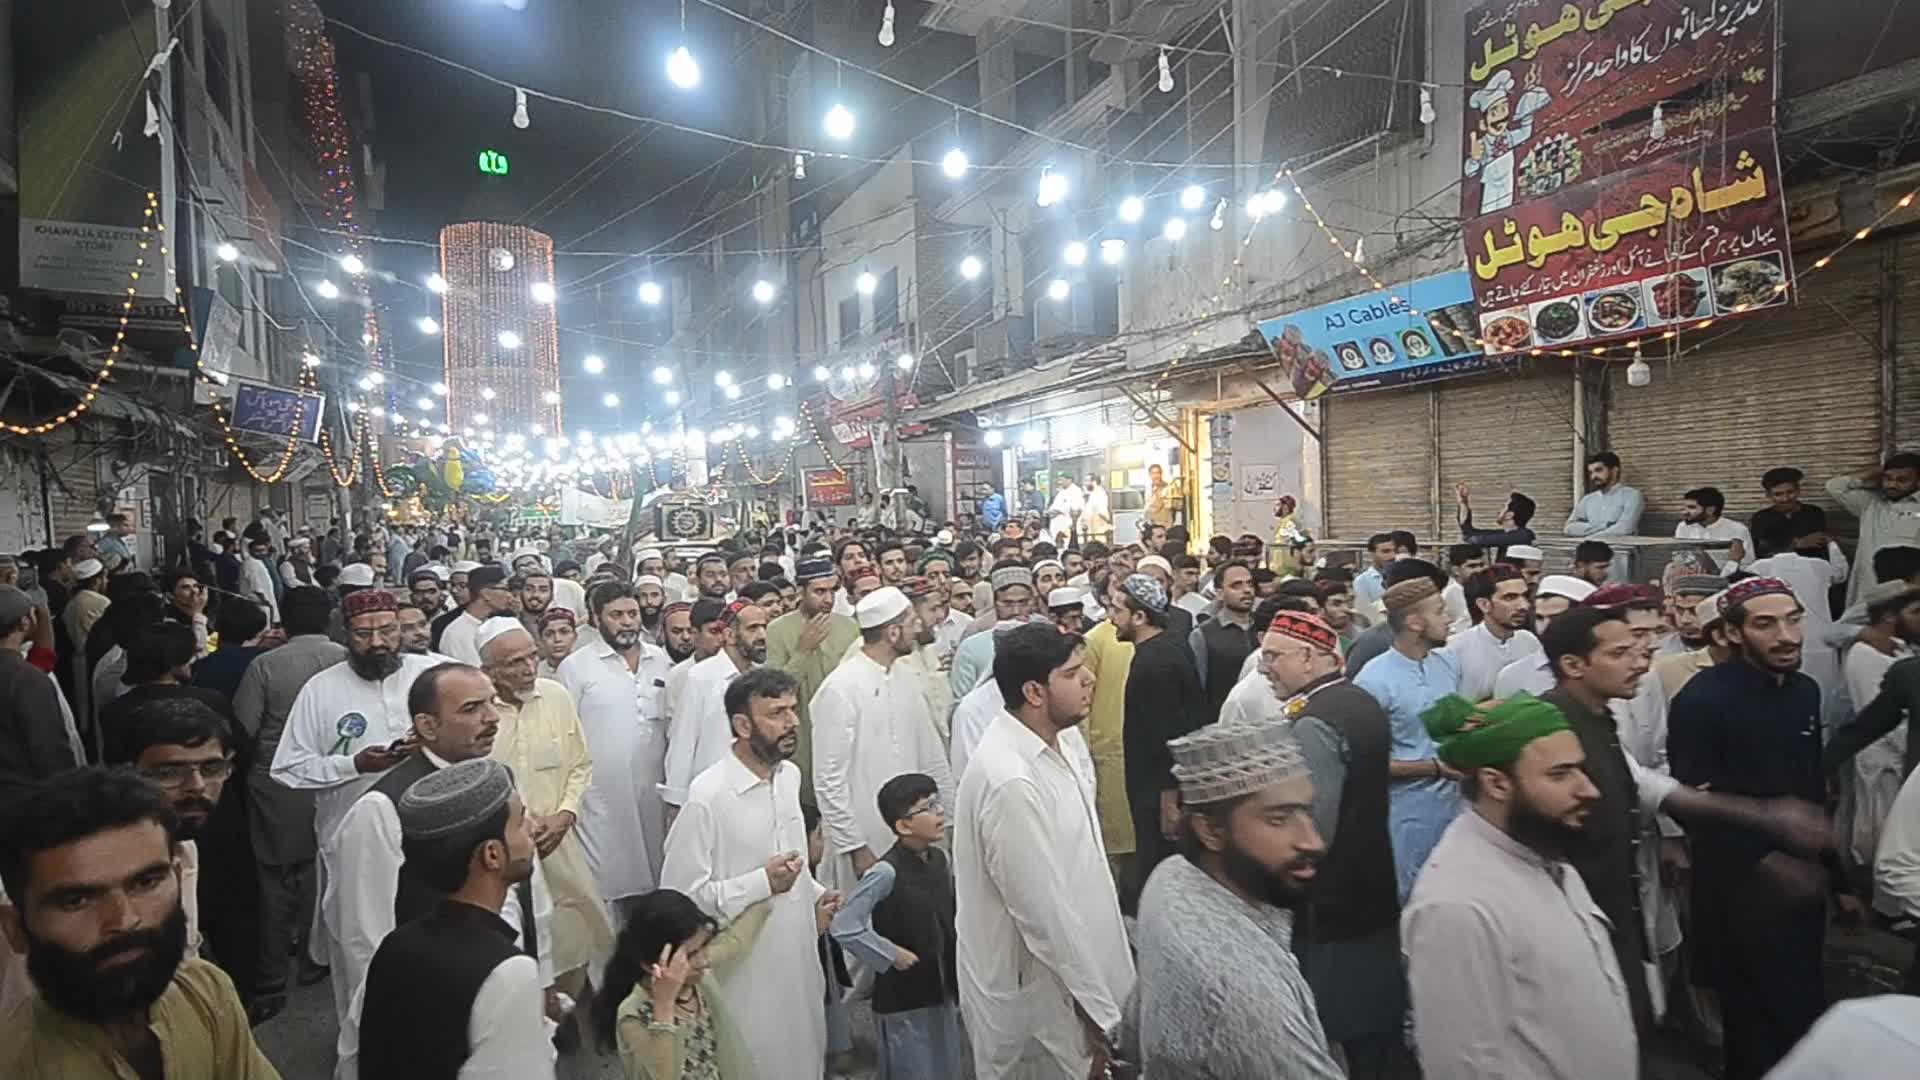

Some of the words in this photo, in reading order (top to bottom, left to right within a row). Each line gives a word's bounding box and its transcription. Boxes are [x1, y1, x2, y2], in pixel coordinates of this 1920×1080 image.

[1470, 3, 1582, 81] ہوٹل
[1559, 40, 1594, 99] مرکز
[1671, 150, 1767, 220] شاہ
[1475, 212, 1585, 280] ہوٹل
[1588, 192, 1667, 252] جی
[1741, 225, 1776, 248] یہاں
[1325, 312, 1346, 331] AJ
[1350, 298, 1411, 325] Cables
